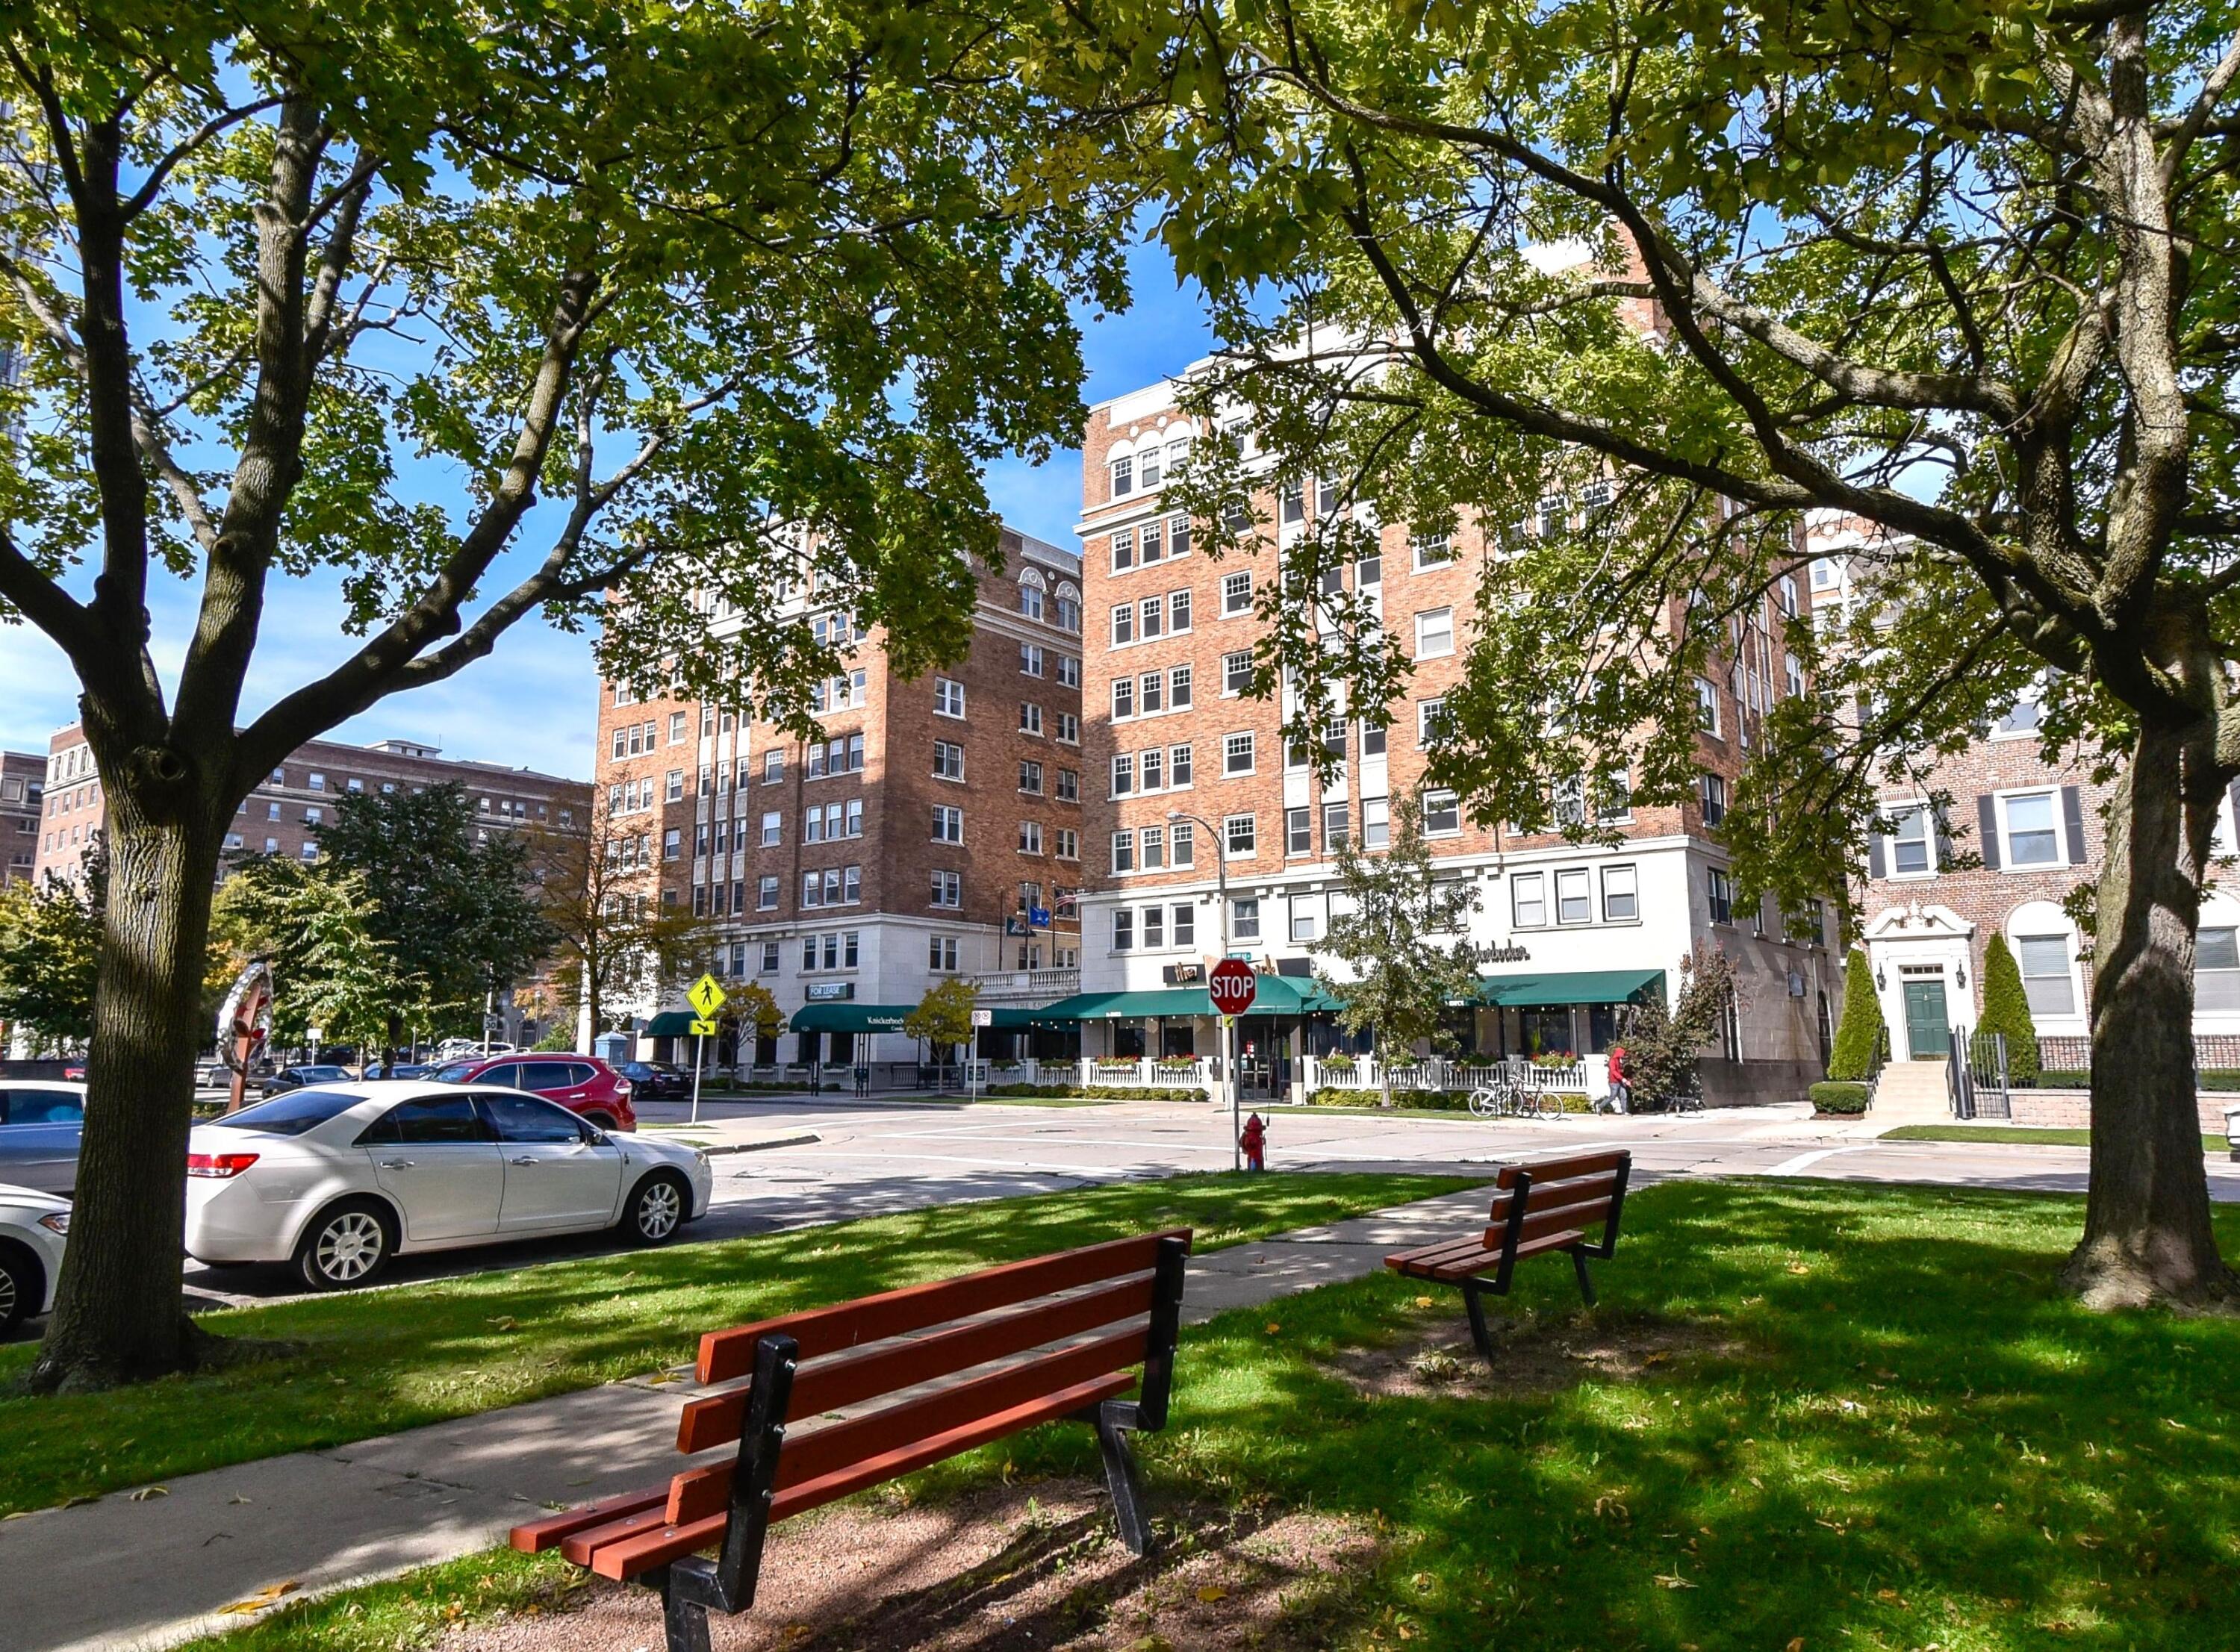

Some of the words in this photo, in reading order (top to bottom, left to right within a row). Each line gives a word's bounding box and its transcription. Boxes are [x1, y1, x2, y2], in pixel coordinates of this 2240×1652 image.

[1174, 961, 1196, 982] the
[810, 986, 823, 996] FOR
[823, 985, 840, 995] LEASE
[1212, 976, 1254, 998] STOP
